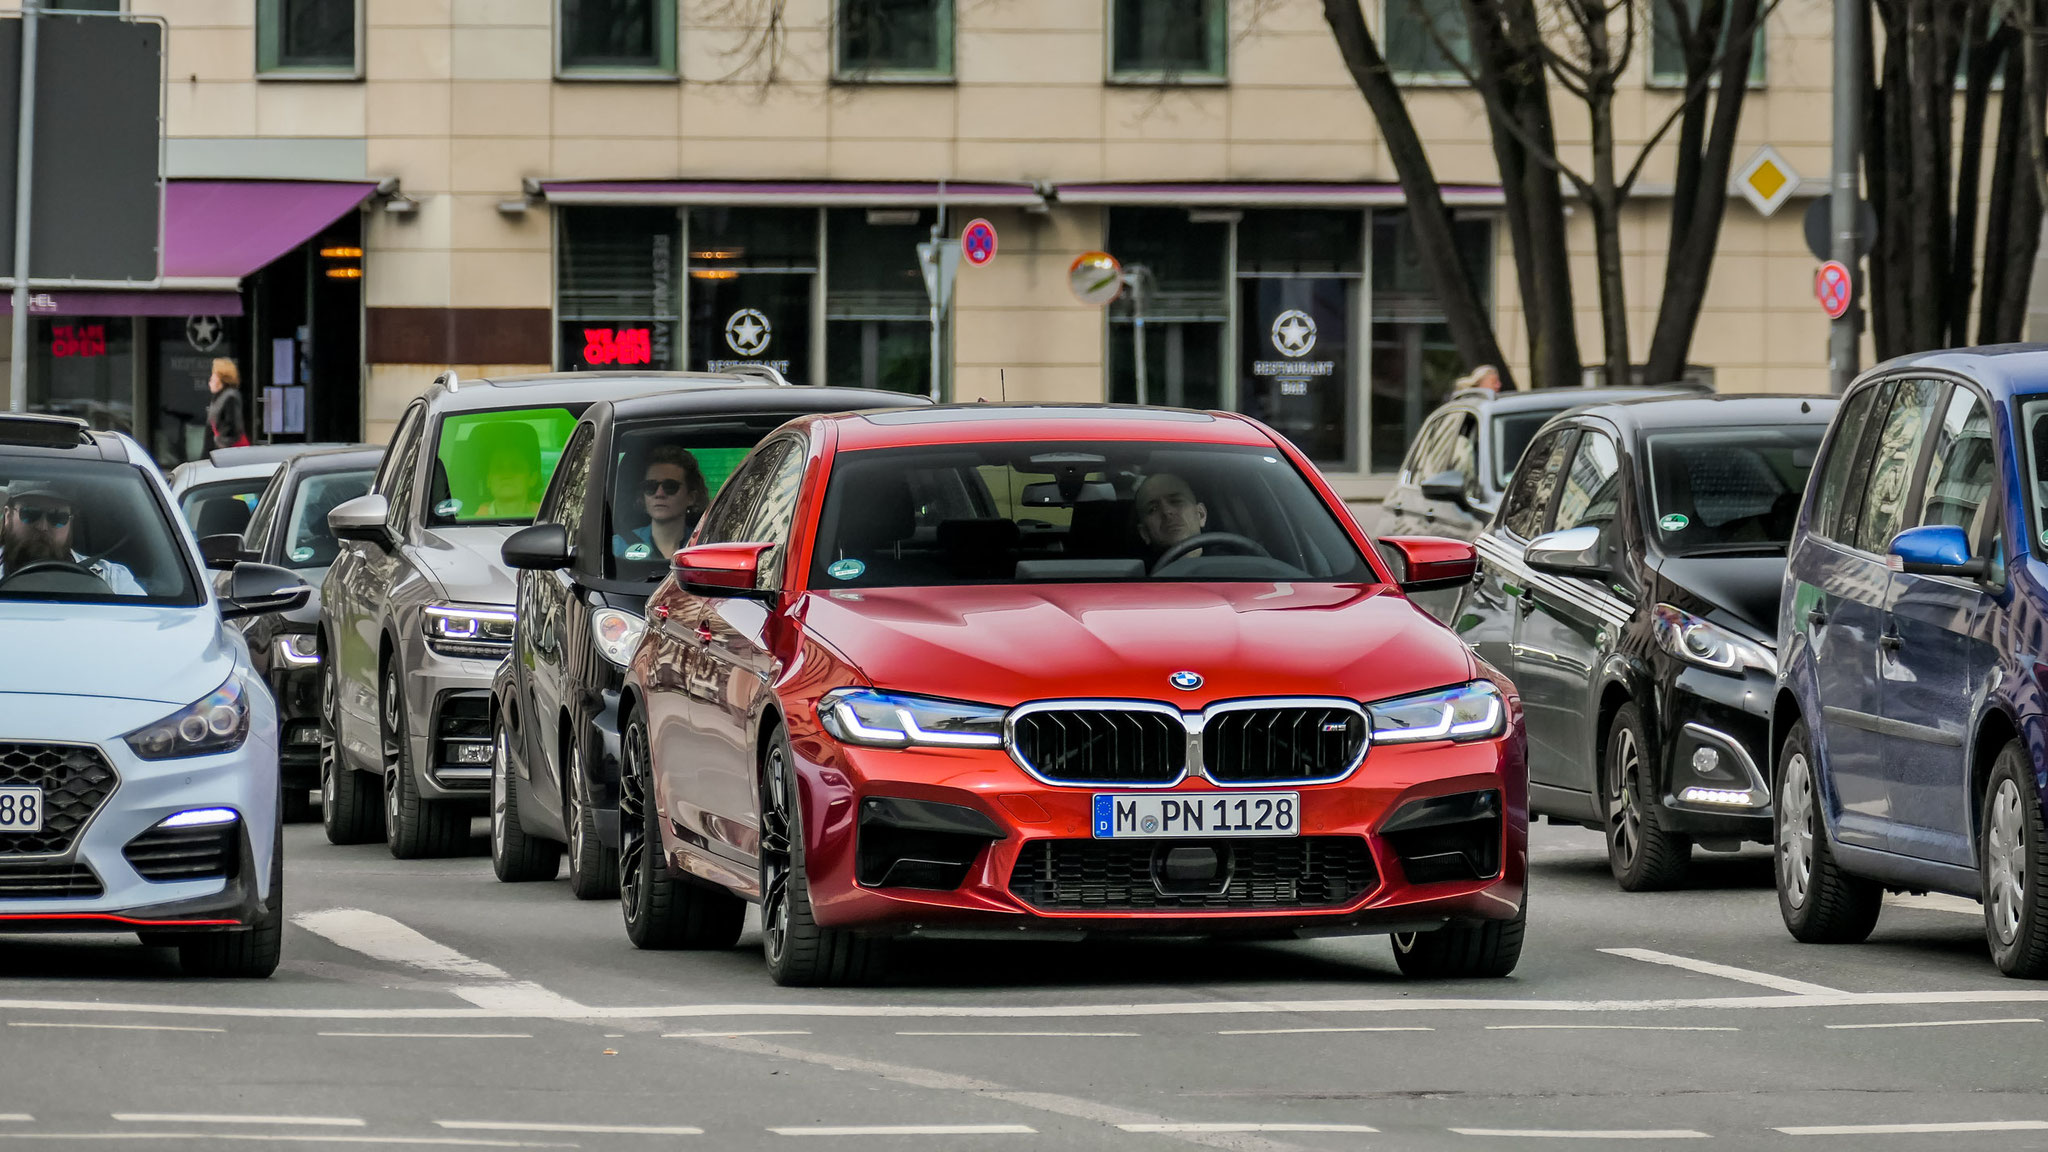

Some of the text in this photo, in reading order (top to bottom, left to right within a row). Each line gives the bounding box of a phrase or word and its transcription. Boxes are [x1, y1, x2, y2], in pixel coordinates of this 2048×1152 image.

[653, 234, 669, 362] RESTAURANT
[52, 338, 105, 357] OPEN
[584, 342, 650, 364] OPEN
[1254, 361, 1334, 375] RESTAURANT
[1281, 381, 1307, 395] BAR
[635, 544, 643, 552] 4
[0, 795, 36, 825] 88
[1116, 798, 1293, 831] M PN 1128
[1100, 821, 1108, 831] D
